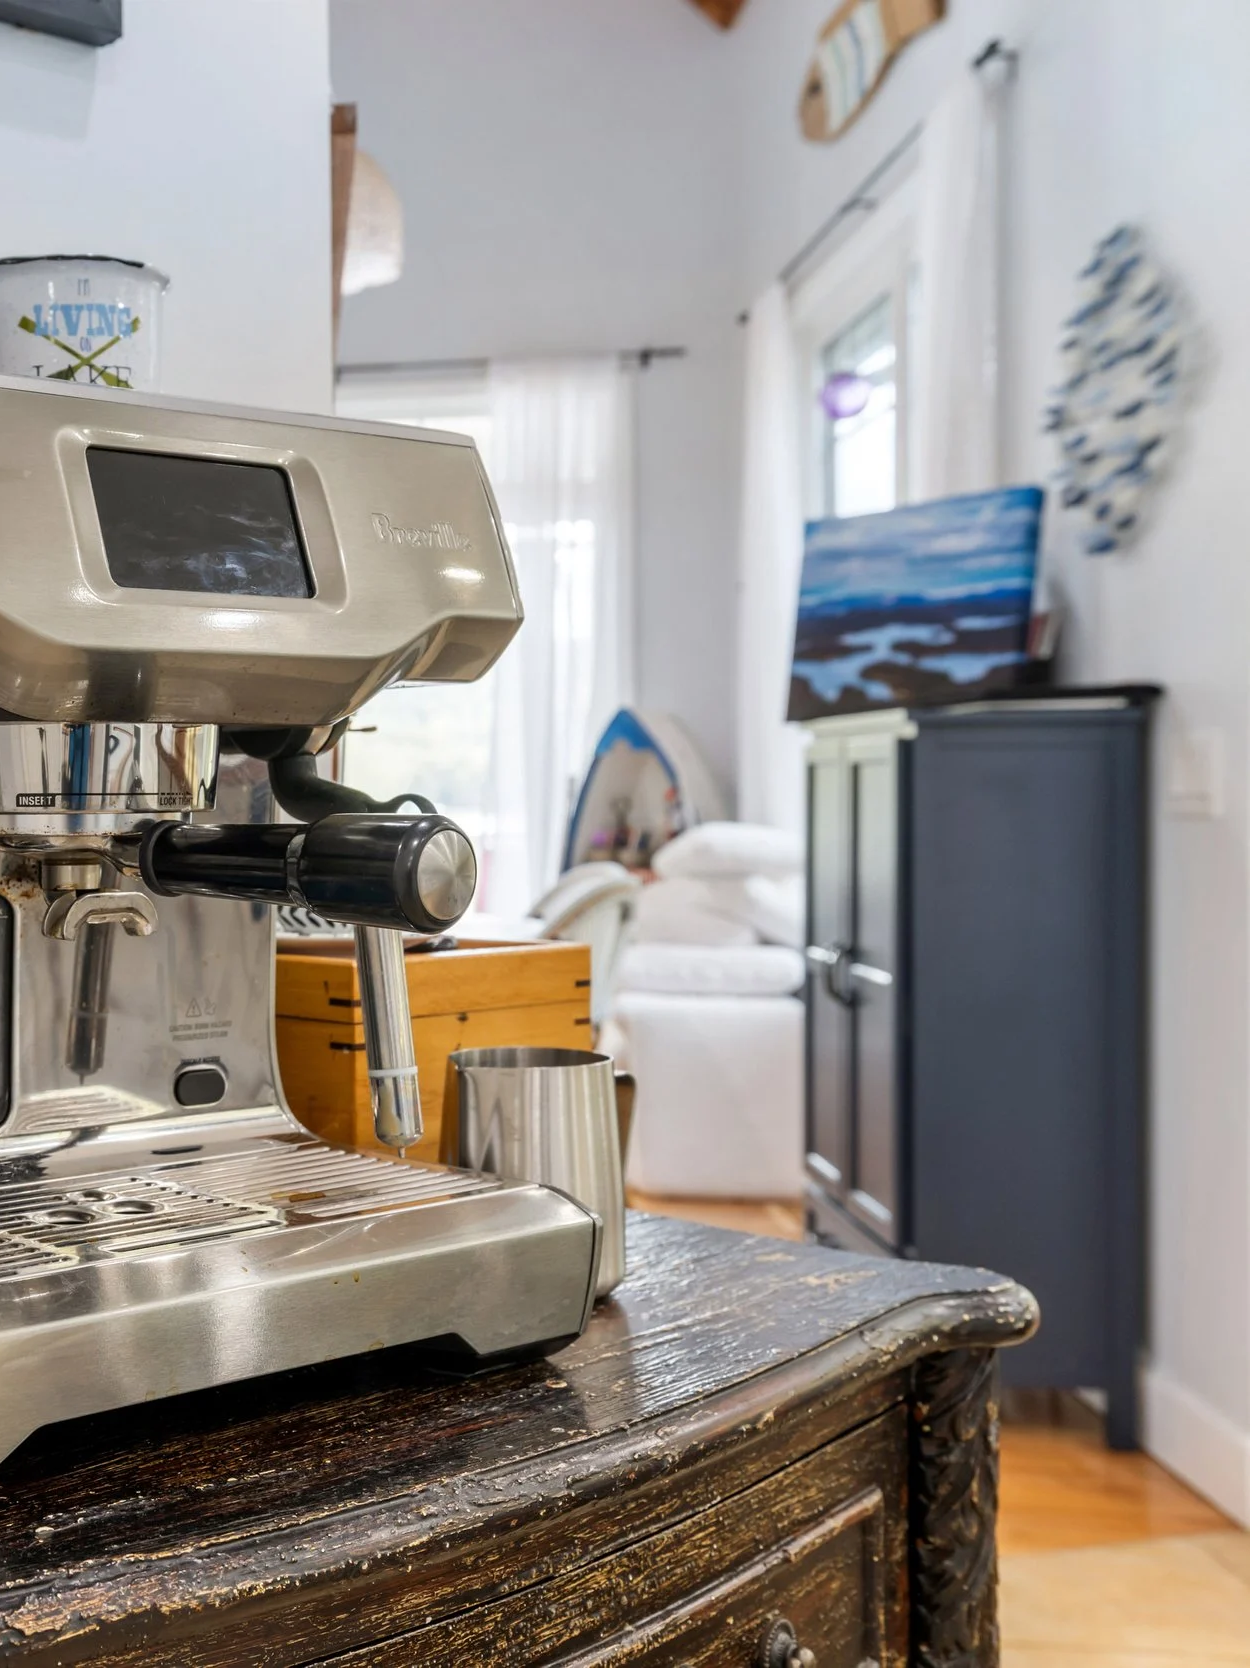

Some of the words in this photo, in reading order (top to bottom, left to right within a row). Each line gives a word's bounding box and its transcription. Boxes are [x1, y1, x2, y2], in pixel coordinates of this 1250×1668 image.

[33, 303, 132, 337] LIVING
[371, 512, 472, 551] Breville
[19, 795, 53, 806] INSERT
[160, 797, 177, 806] LOCK
